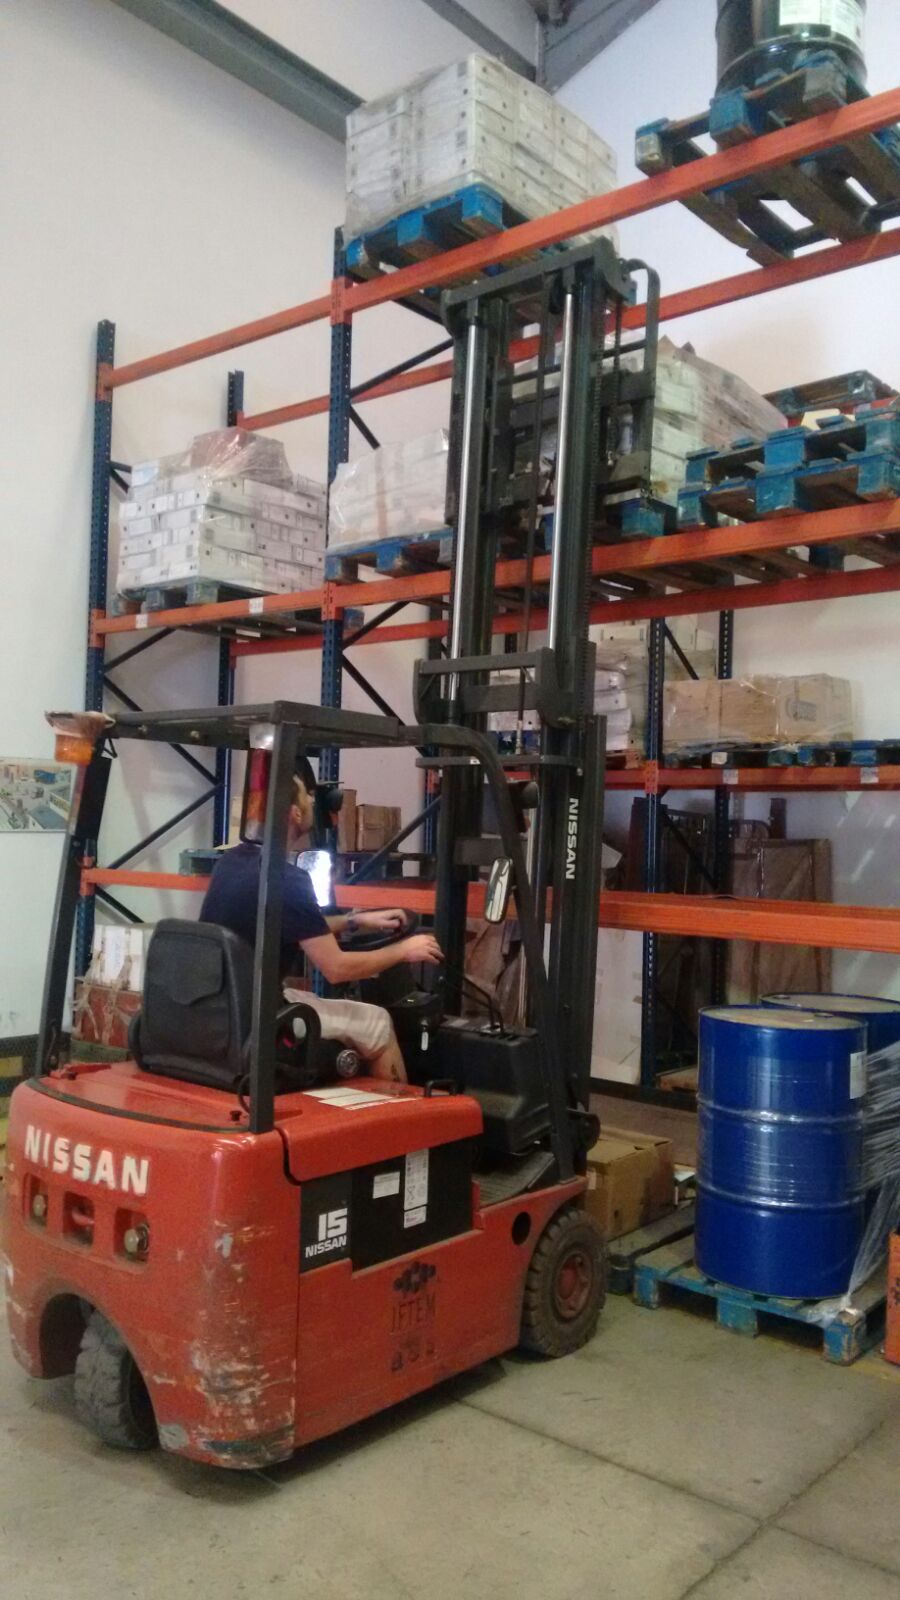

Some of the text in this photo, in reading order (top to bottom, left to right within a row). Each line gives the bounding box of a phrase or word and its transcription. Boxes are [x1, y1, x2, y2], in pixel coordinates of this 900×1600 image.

[565, 797, 580, 880] NISSAN
[24, 1124, 149, 1197] NISSAN
[304, 1234, 348, 1259] NISSAN
[318, 1207, 348, 1242] 15
